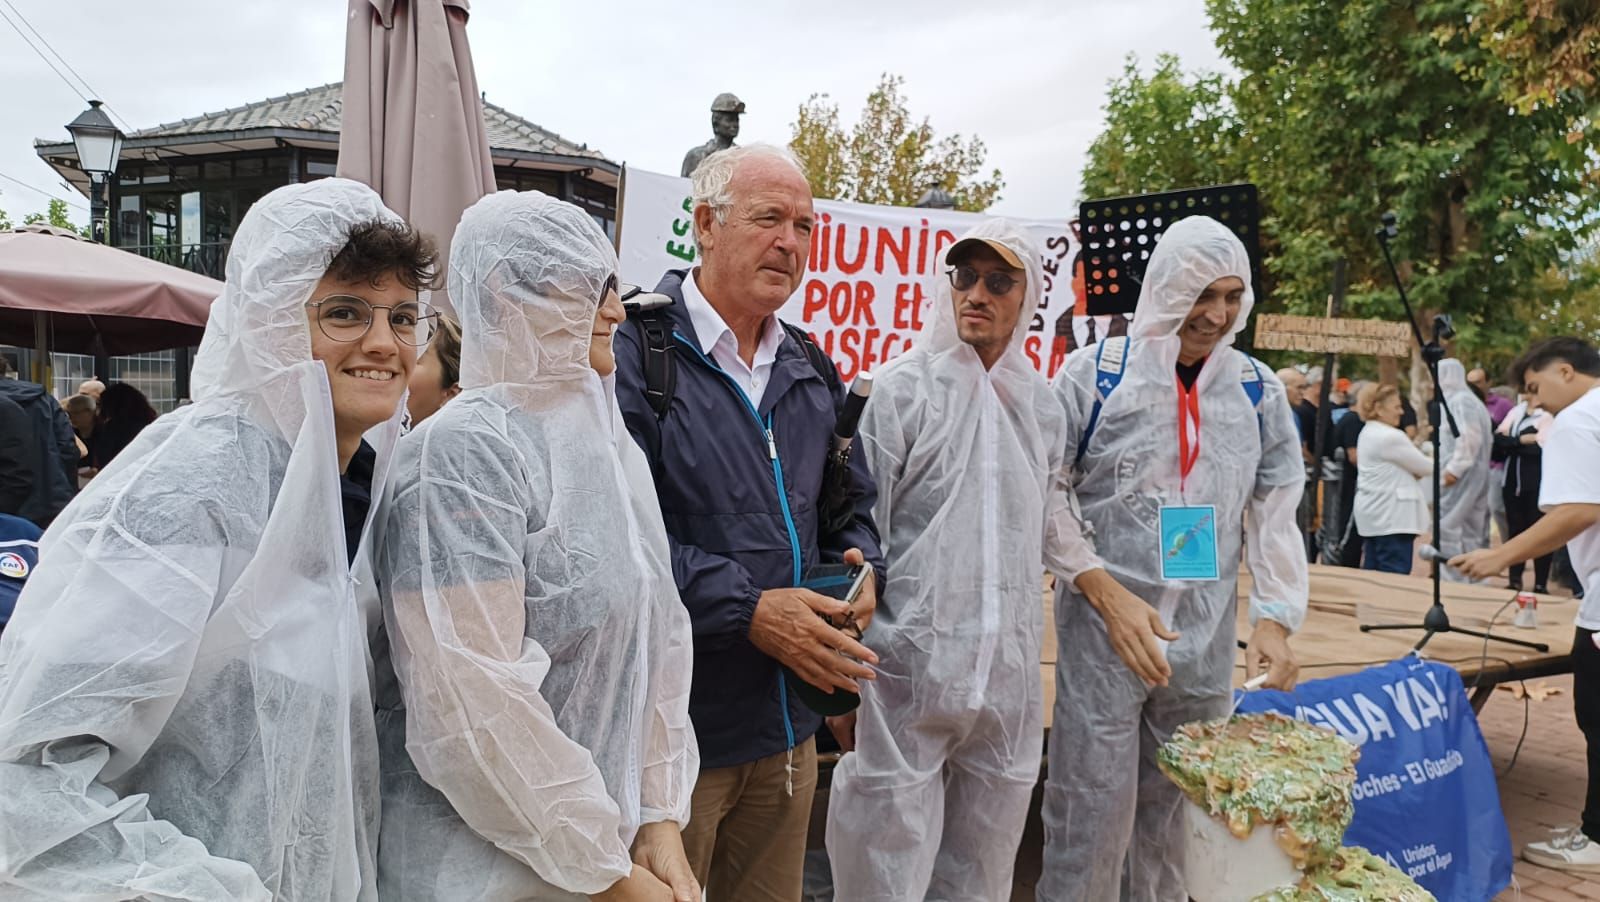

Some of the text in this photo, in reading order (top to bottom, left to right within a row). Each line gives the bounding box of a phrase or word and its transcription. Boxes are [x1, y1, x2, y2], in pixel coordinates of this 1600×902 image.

[802, 279, 924, 331] POR EL
[1266, 671, 1448, 746] GUA YA!
[1352, 773, 1401, 801] oches
[1404, 761, 1427, 785] El
[1402, 844, 1437, 864] Unidos
[1426, 857, 1437, 873] el
